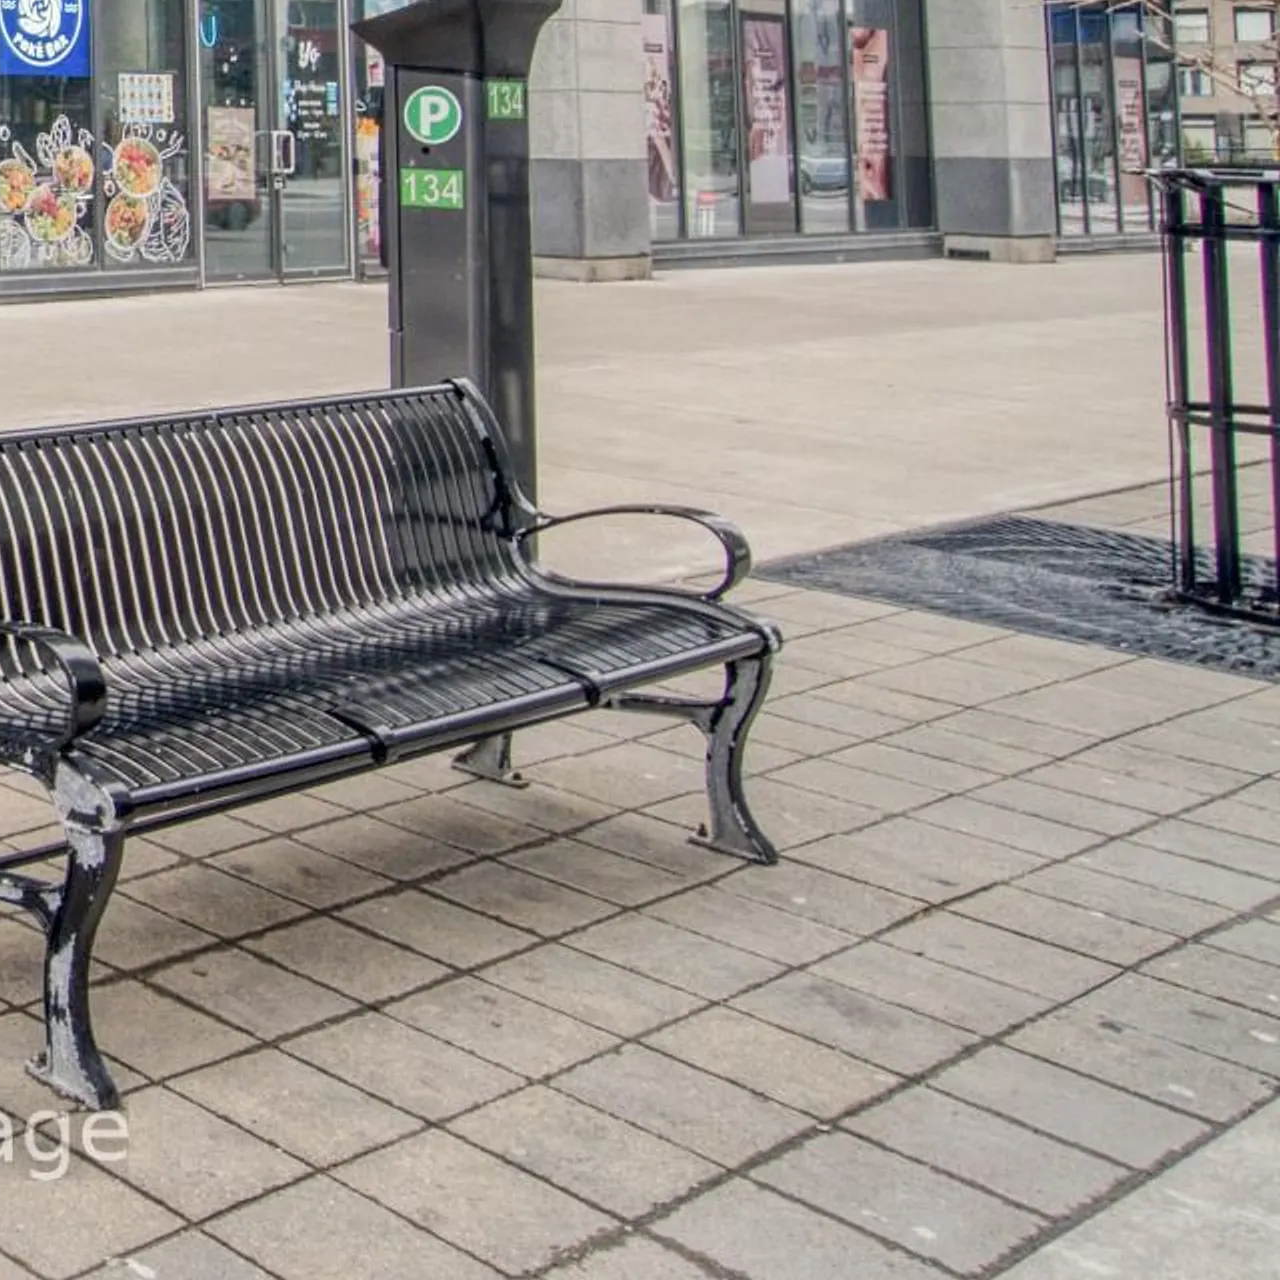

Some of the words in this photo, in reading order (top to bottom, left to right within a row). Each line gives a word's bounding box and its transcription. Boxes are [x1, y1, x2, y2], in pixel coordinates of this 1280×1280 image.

[420, 95, 450, 137] P
[488, 84, 524, 116] 134
[404, 172, 461, 205] 134
